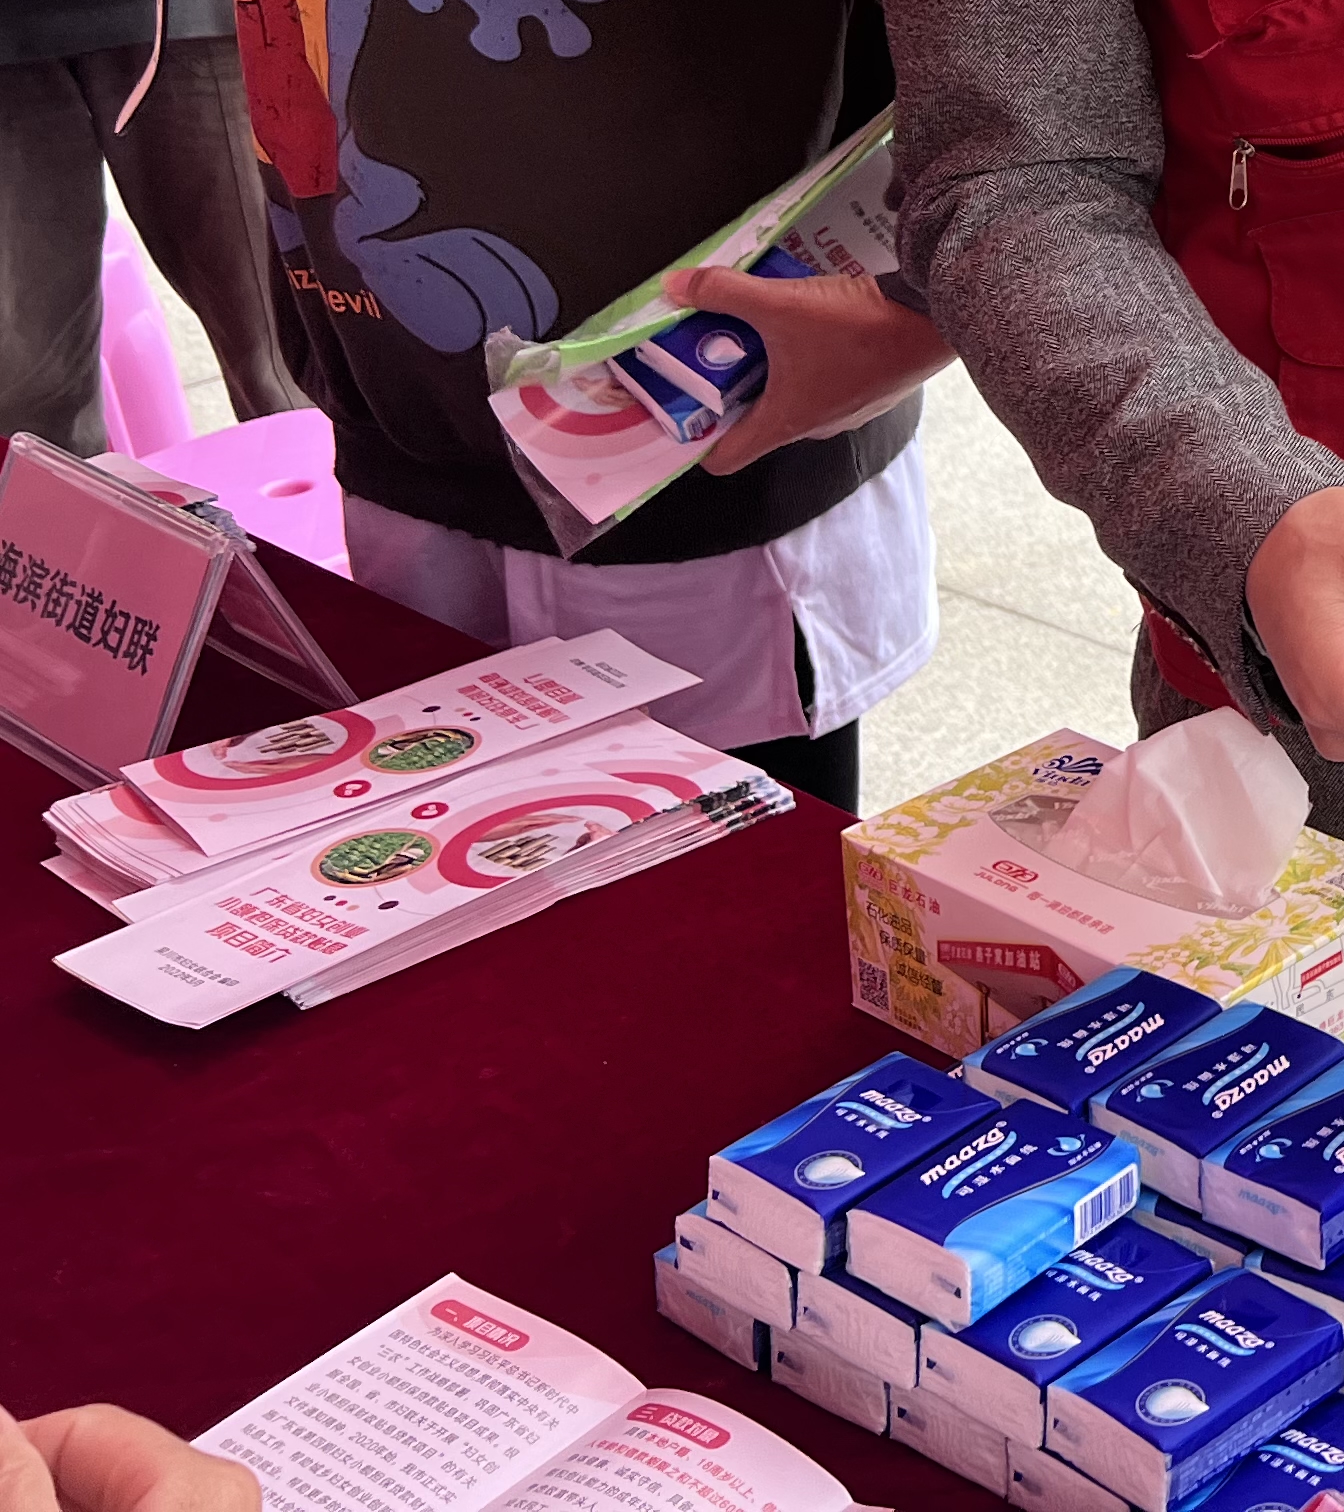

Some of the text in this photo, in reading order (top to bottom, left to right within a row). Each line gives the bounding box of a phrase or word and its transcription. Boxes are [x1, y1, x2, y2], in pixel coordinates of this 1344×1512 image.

[250, 887, 370, 939] 广东省妇女创业
[888, 878, 941, 916] 巨龙石油
[205, 921, 292, 964] 项目简介
[214, 896, 348, 955] 小额担保贷款贴息
[879, 930, 927, 966] 保质保量
[896, 962, 943, 996] 诚信经营
